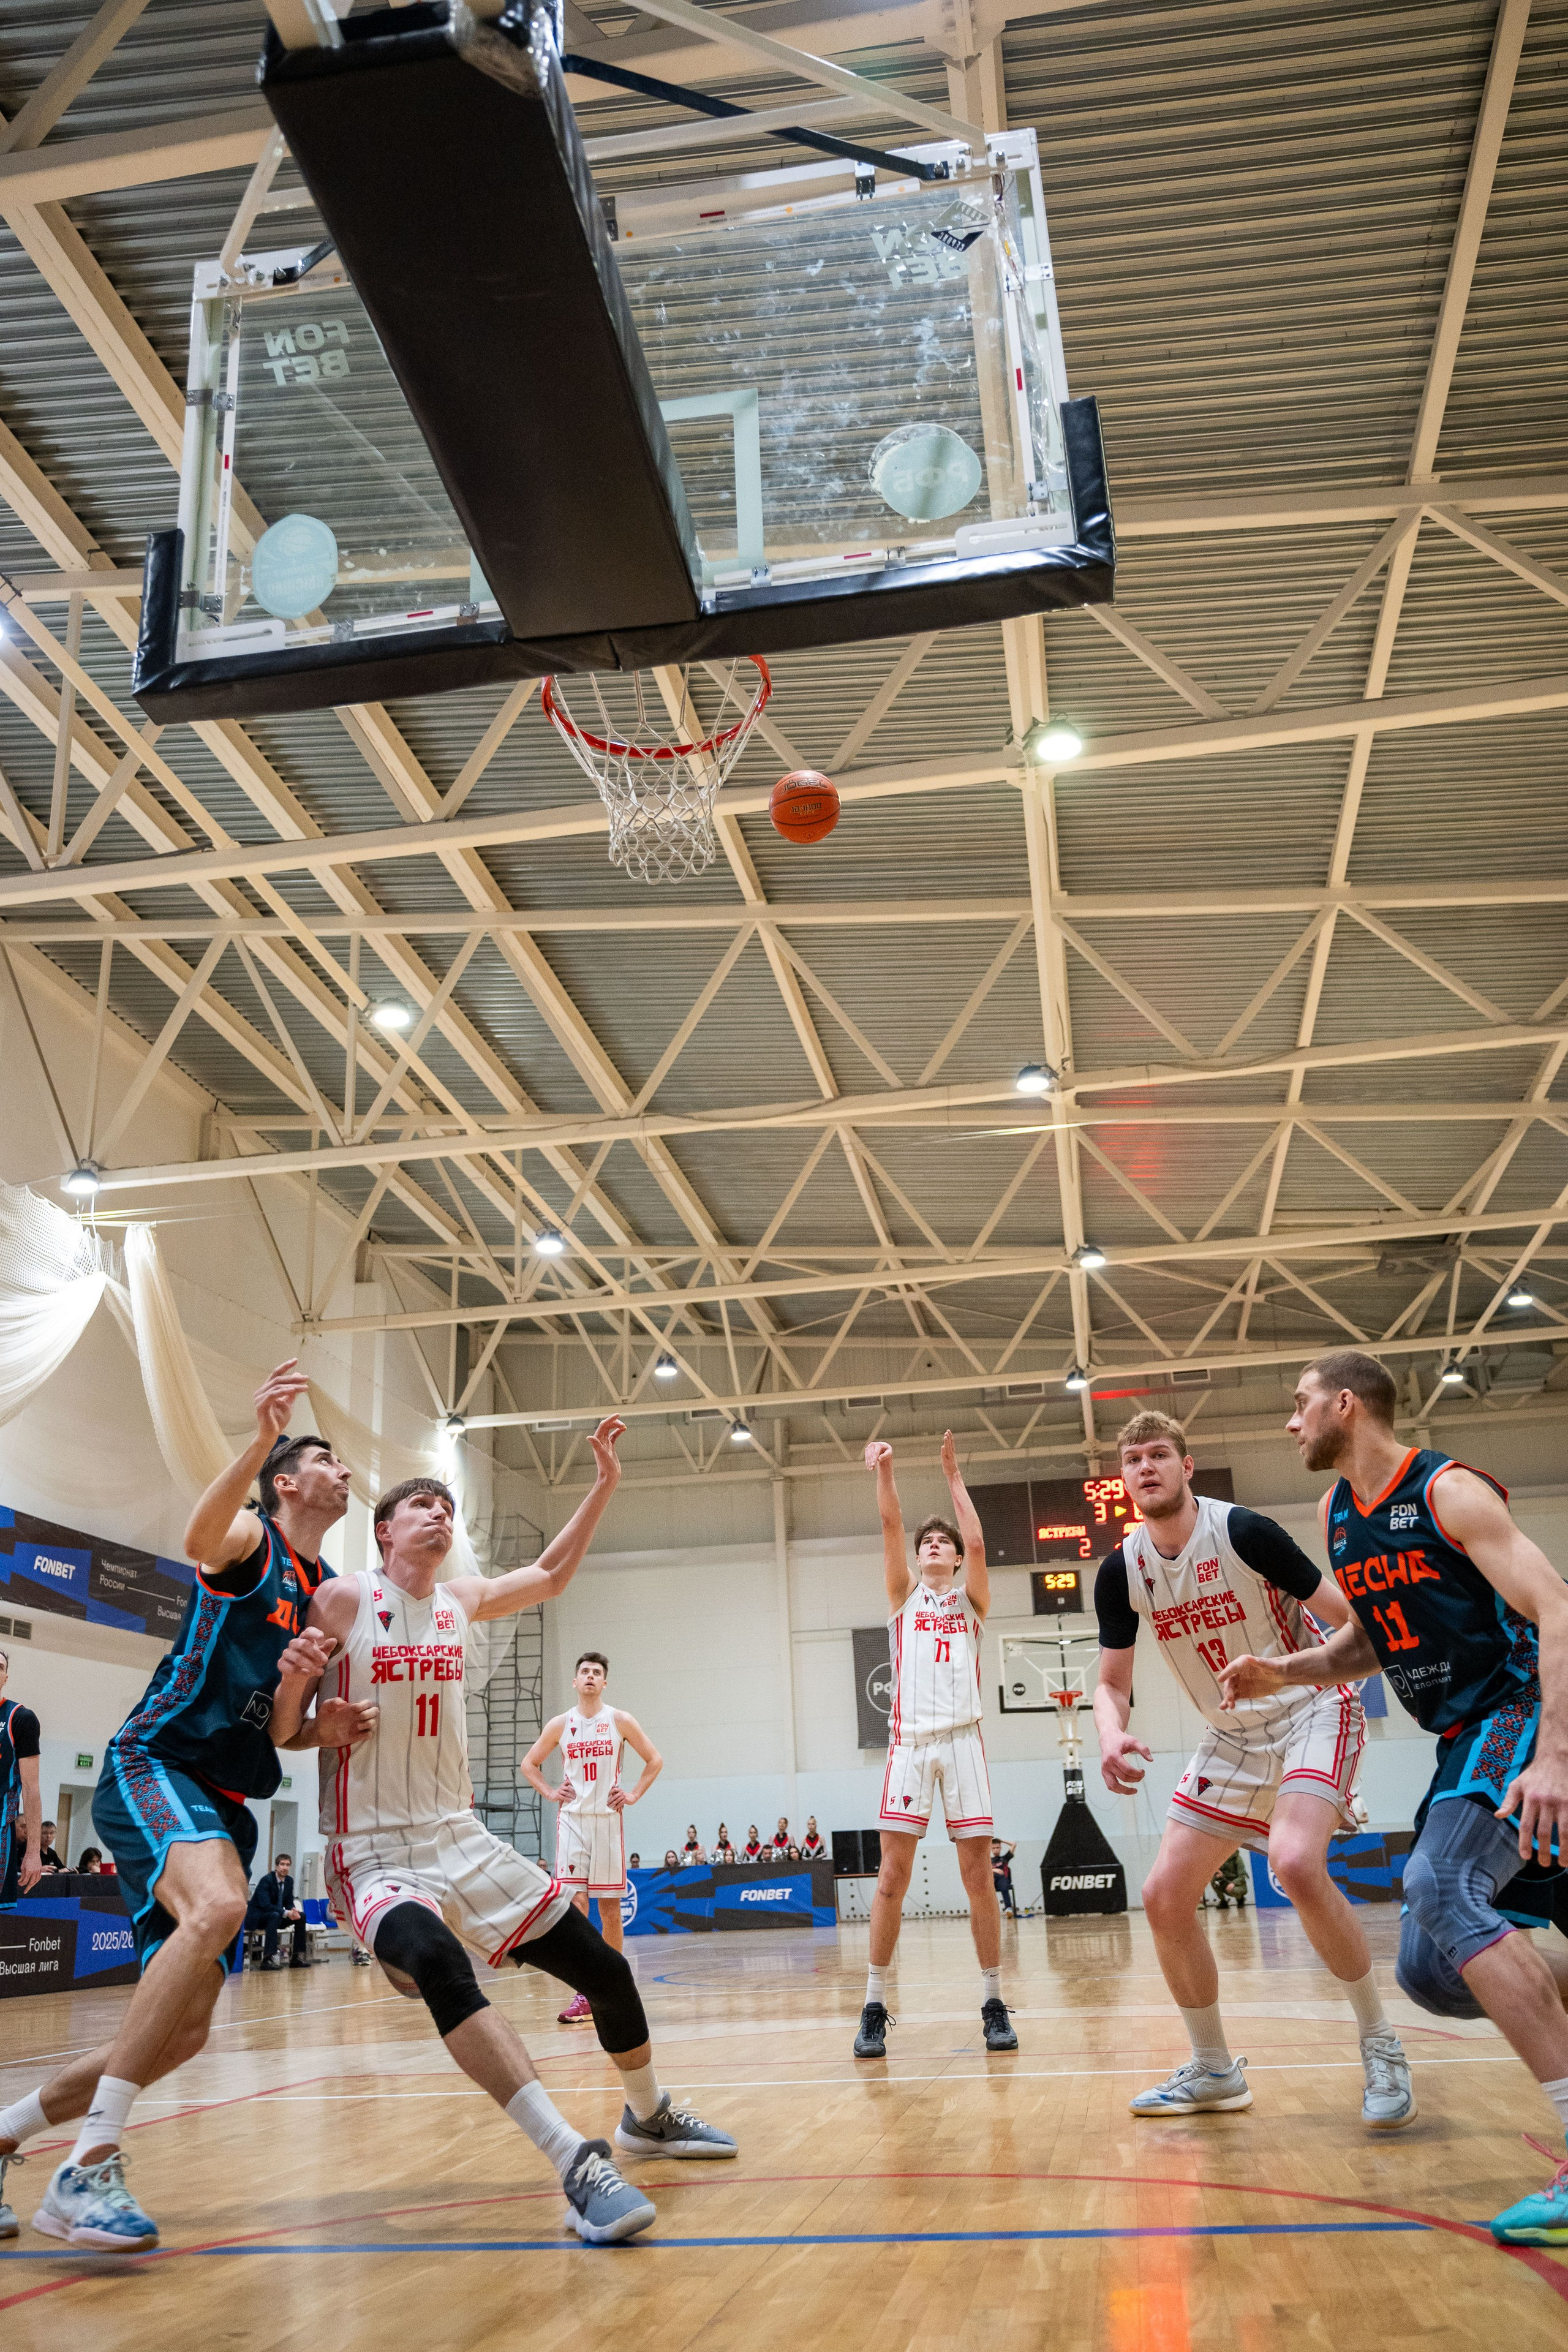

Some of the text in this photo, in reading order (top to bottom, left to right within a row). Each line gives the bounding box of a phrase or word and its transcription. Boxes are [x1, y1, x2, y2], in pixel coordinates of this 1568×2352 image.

[1084, 1479, 1125, 1501] 5:29
[1094, 1502, 1107, 1523] 3
[1390, 1504, 1417, 1516] FON
[1390, 1517, 1419, 1530] BET
[1038, 1525, 1086, 1540] ЯСТРЕБЫ
[1079, 1537, 1091, 1558] 2
[34, 1555, 76, 1580] FONBET
[101, 1559, 138, 1578] Чемпионат
[1196, 1558, 1219, 1574] FON
[99, 1574, 126, 1591] России
[1045, 1573, 1076, 1589] 5:29
[1197, 1568, 1219, 1583] BET
[157, 1605, 181, 1621] Высшая
[435, 1610, 454, 1620] FON
[437, 1619, 455, 1630] BET
[1155, 1602, 1247, 1642] ЯСТРЕБЫ
[1373, 1600, 1420, 1652] 11
[372, 1645, 463, 1660] ЧЕБОКСАРСКИЕ
[1197, 1638, 1229, 1673] 13
[371, 1657, 464, 1684] ЯСТРЕБЫ
[416, 1693, 440, 1736] 11
[567, 1740, 612, 1749] ЧЕБОКСАРСКИЕ
[567, 1746, 613, 1760] ЯСТРЕБЫ
[583, 1762, 597, 1782] 10
[1050, 1874, 1117, 1891] FONBET
[740, 1888, 793, 1902] FONBET
[29, 1930, 134, 1952] Fonbet 2025/26
[0, 1960, 59, 1976] Высшая лига
